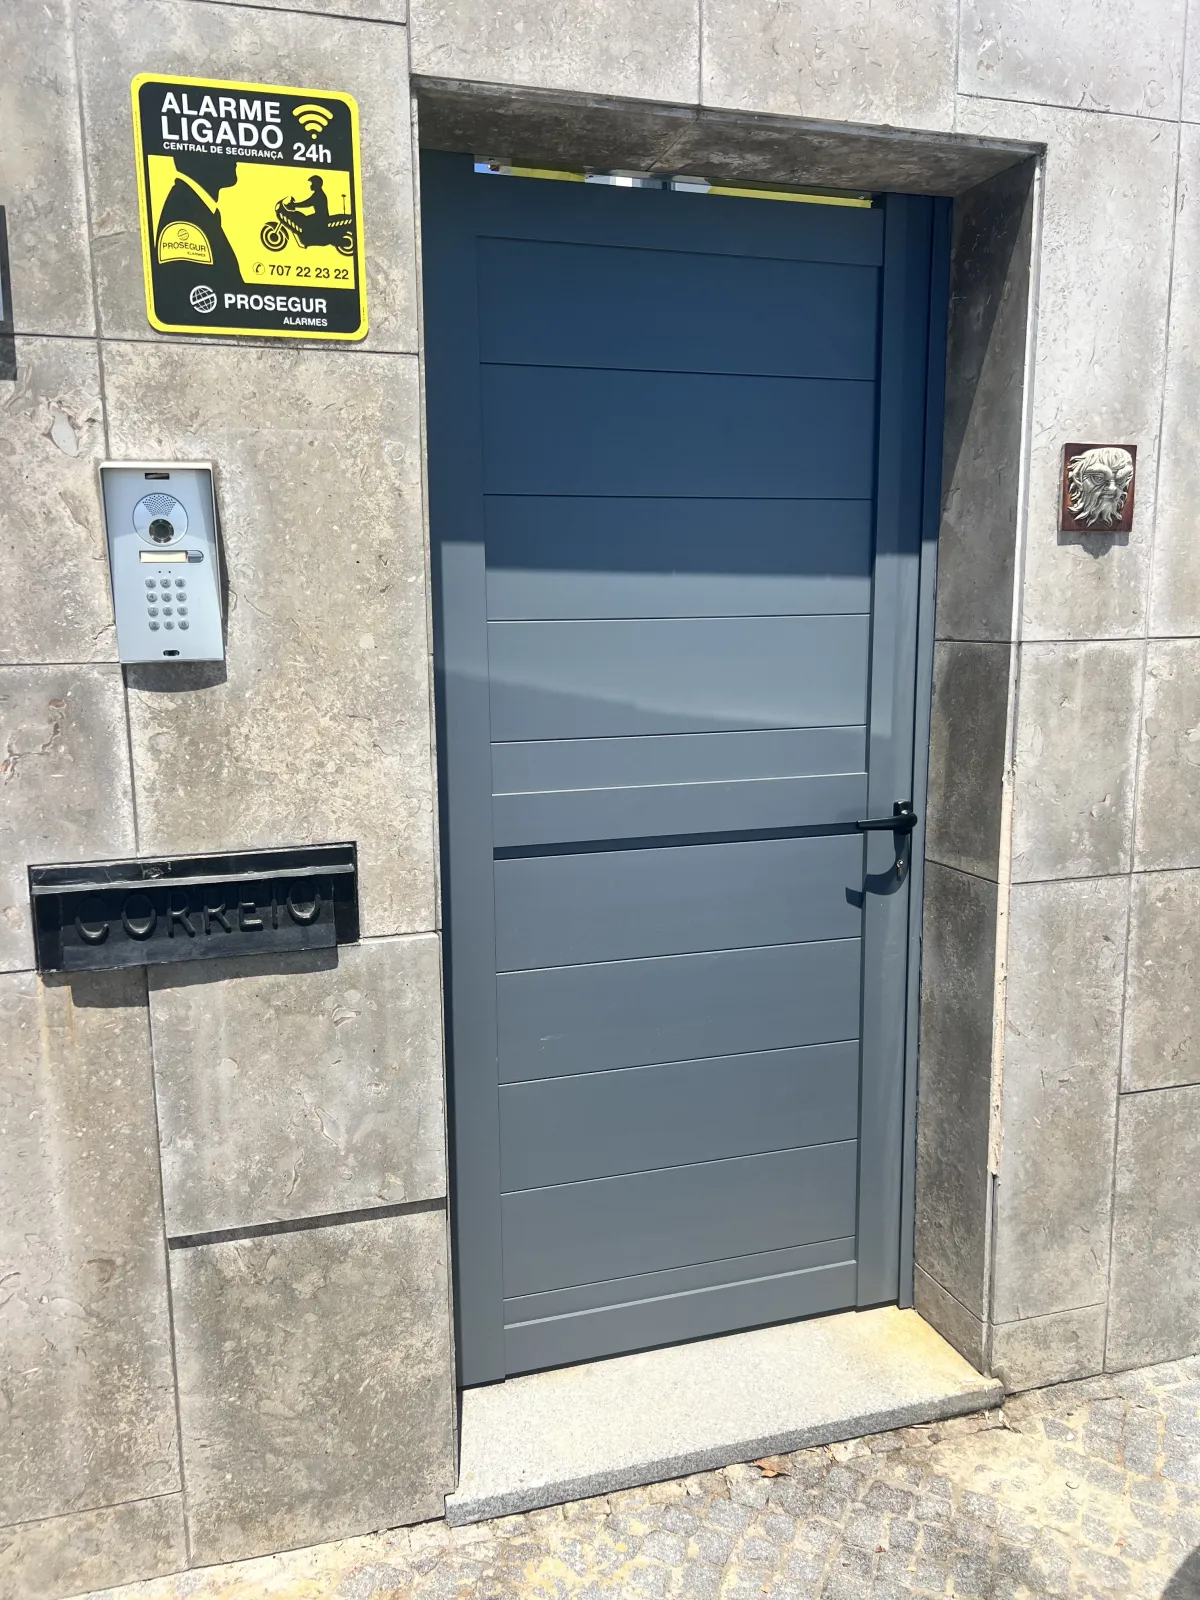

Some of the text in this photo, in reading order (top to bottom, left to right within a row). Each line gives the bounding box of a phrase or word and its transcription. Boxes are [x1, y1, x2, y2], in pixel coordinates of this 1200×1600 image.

[161, 92, 281, 123] ALARME
[161, 115, 284, 149] LIGADO
[163, 141, 284, 160] CENTRAL DE SEGURANÇA
[293, 142, 332, 164] 24h
[163, 241, 206, 252] PROSEGUR
[269, 264, 349, 280] 707 22 23 22
[224, 293, 327, 314] PROSEGUR
[283, 317, 328, 327] ALARMES
[75, 880, 321, 945] CORREIO
